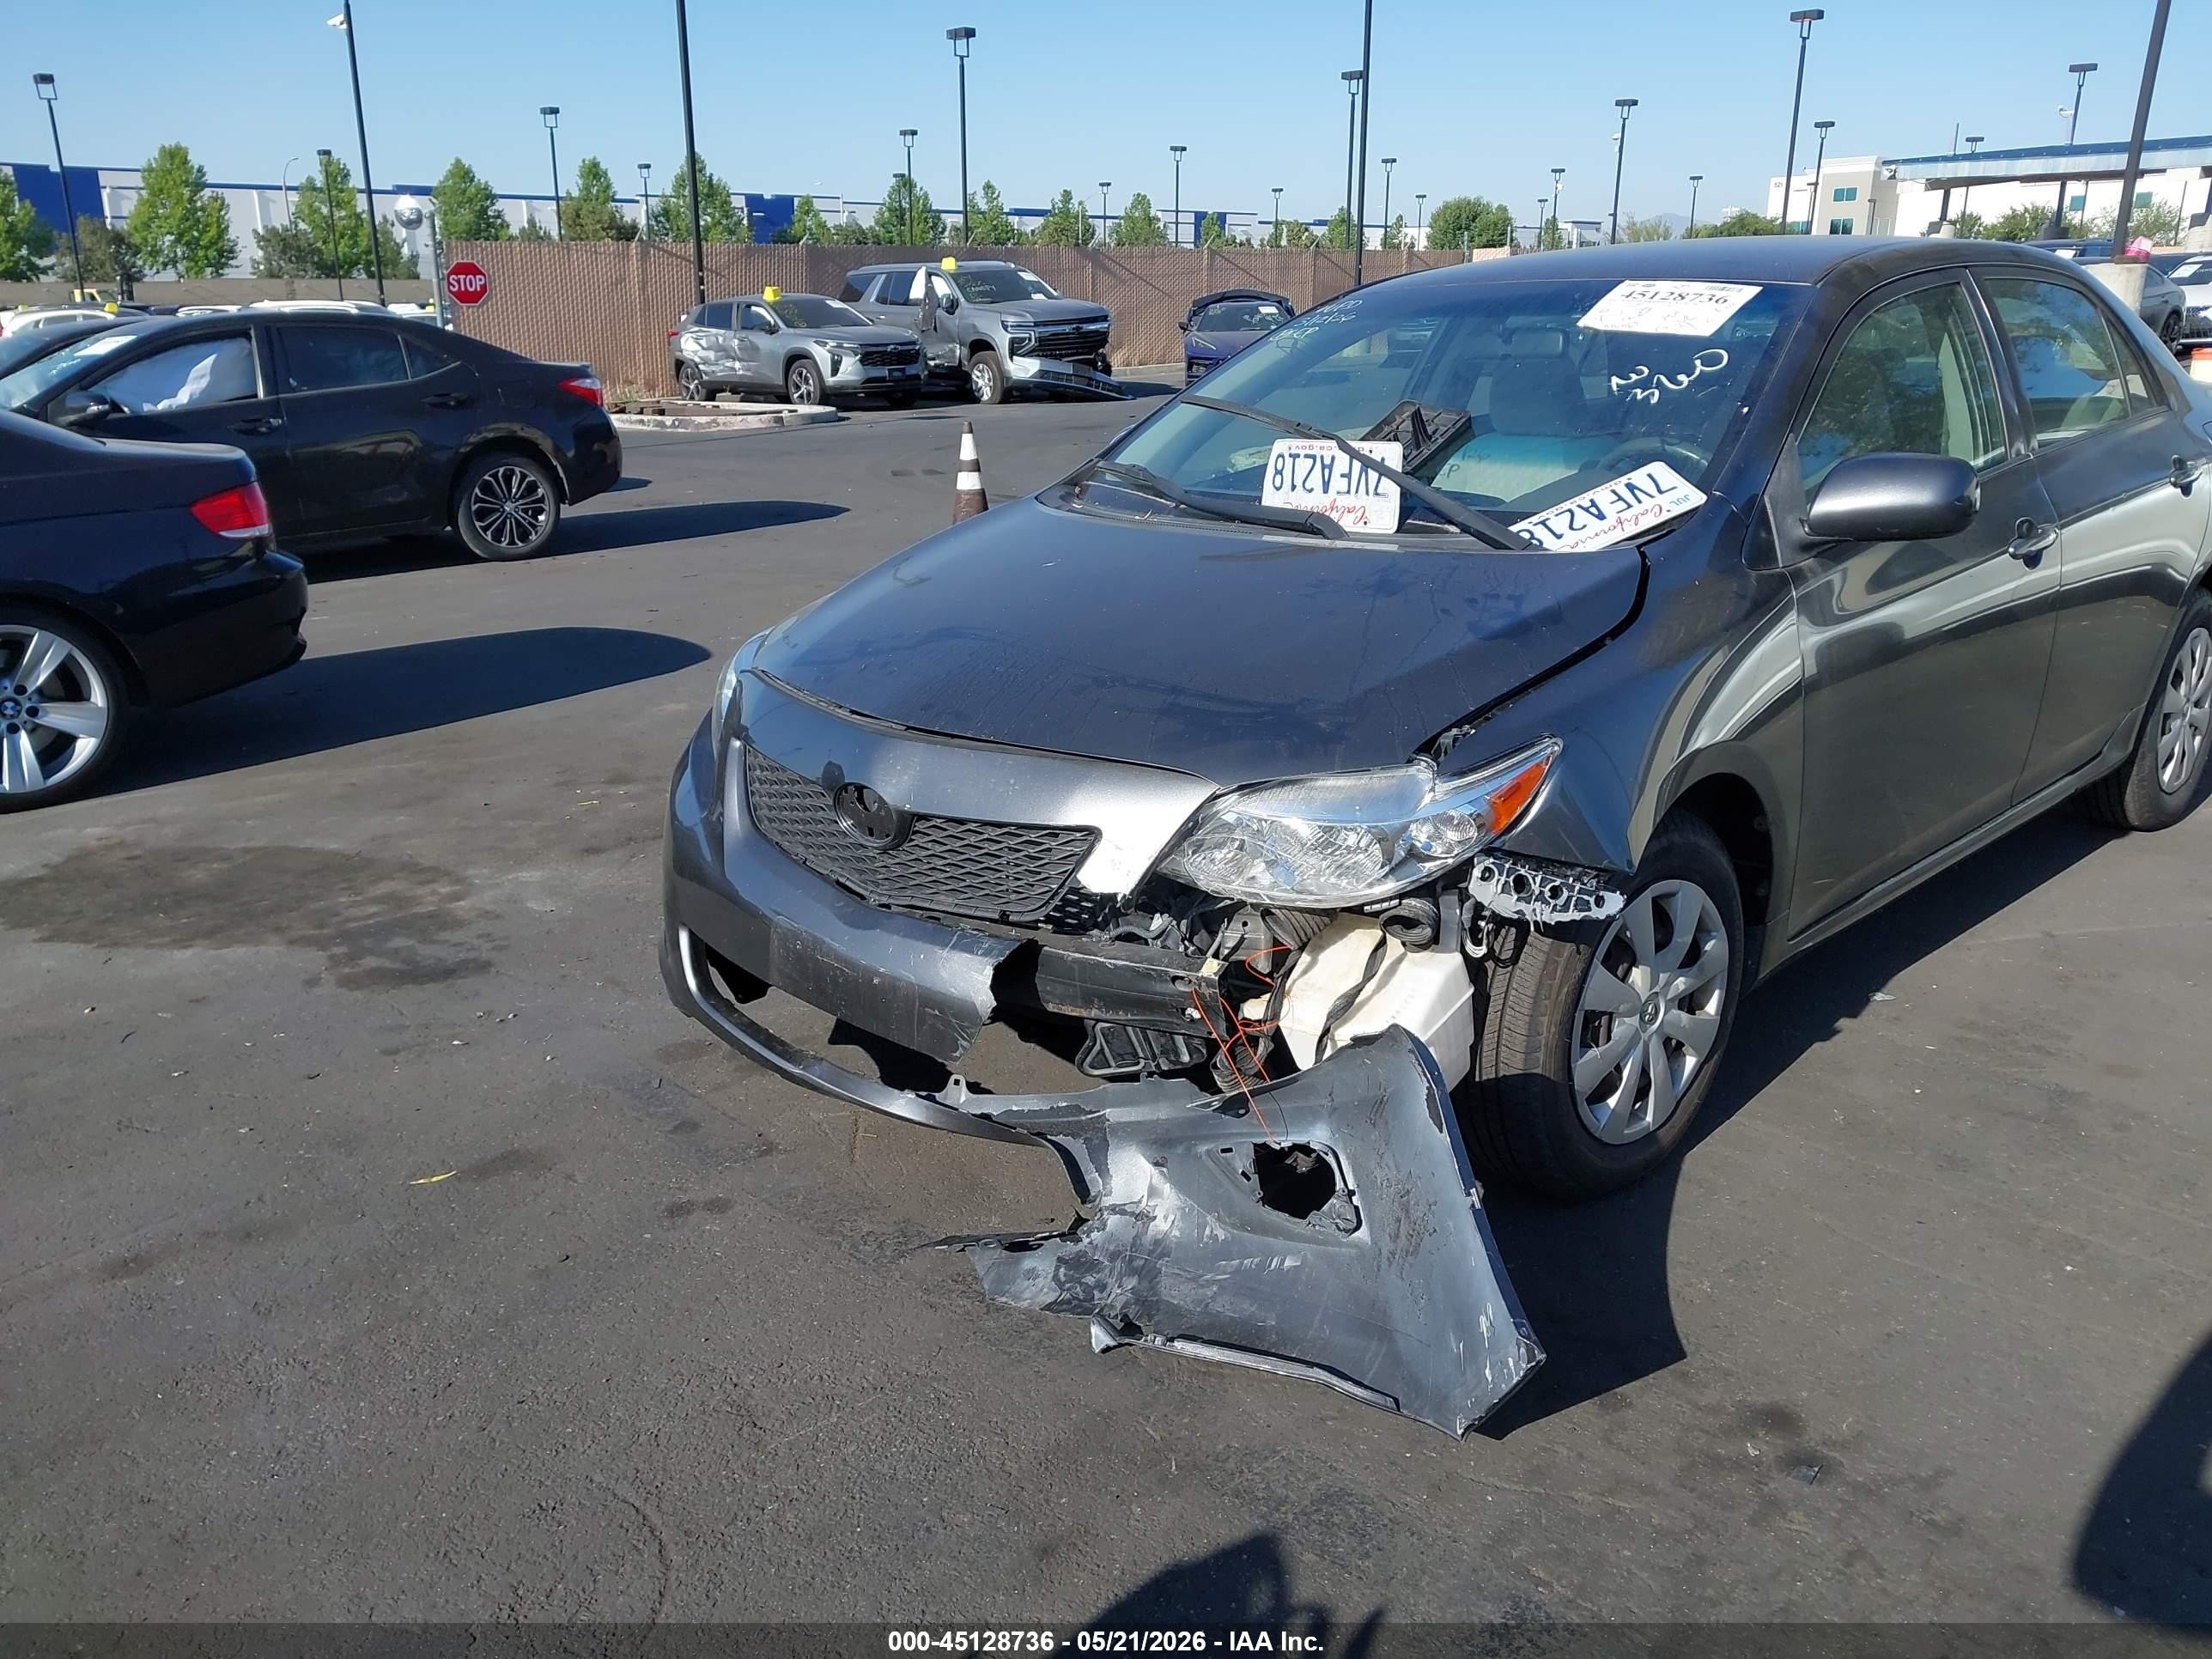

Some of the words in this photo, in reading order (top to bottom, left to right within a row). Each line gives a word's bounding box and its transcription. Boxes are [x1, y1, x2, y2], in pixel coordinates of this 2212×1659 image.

[449, 274, 485, 292] STOP
[1620, 289, 1729, 305] 45128736
[1294, 445, 1365, 454] d.ca.gov
[1272, 452, 1389, 498] 7VFA218
[1668, 494, 1692, 507] JUL
[1516, 472, 1678, 548] 7VFA218
[1555, 503, 1663, 551] California
